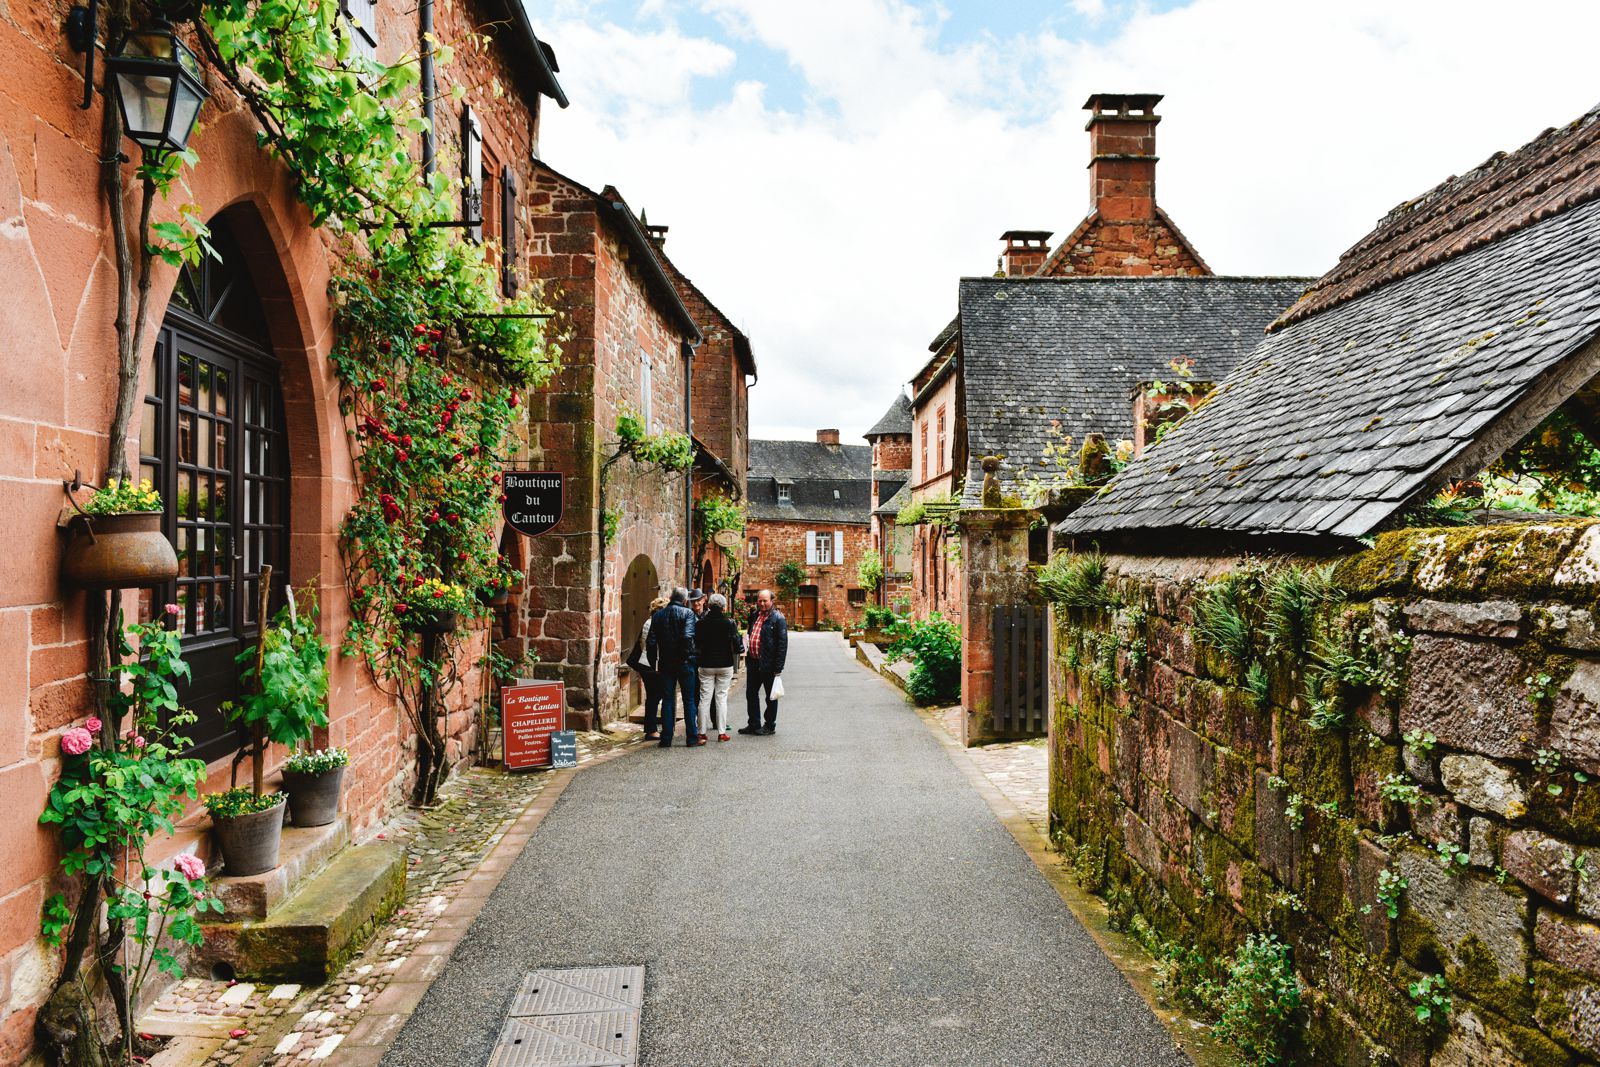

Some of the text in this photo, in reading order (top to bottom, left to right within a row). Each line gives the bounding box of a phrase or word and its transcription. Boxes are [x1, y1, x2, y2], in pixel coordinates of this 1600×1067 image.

[506, 476, 561, 490] Boutique
[526, 494, 540, 506] du
[511, 511, 555, 524] Cantou
[517, 695, 550, 704] Boutique
[532, 703, 560, 711] Cantou
[511, 717, 558, 728] CHAPELLERIE
